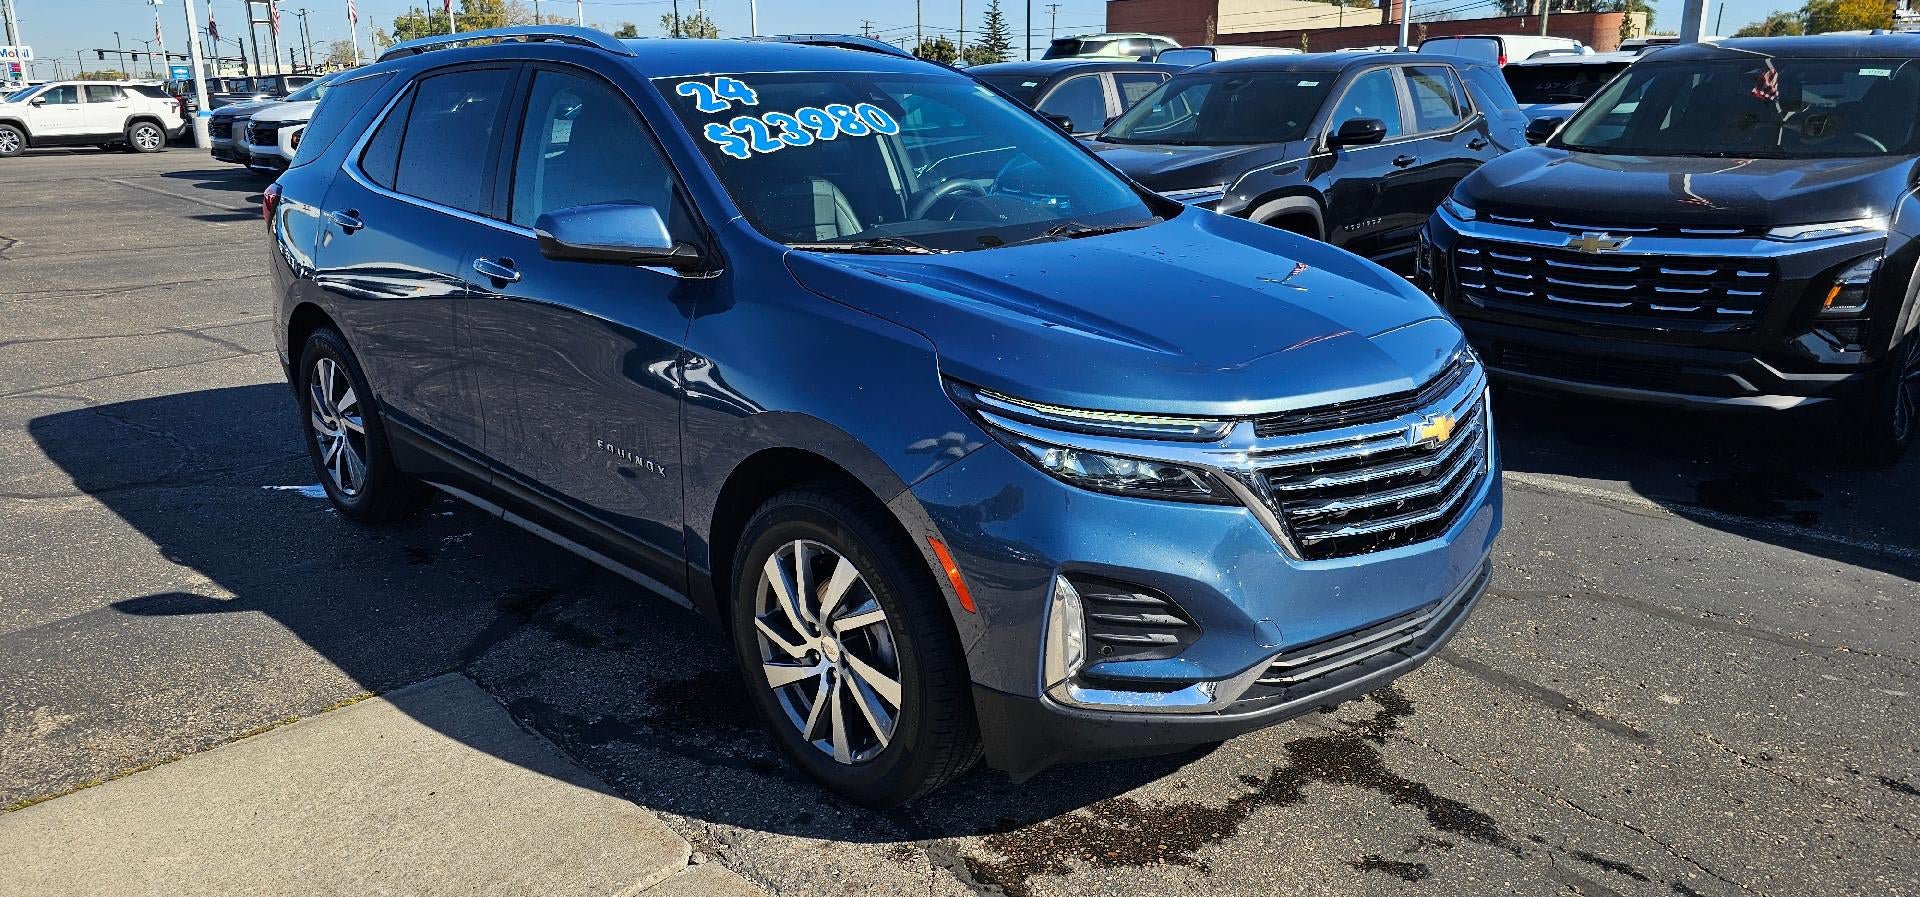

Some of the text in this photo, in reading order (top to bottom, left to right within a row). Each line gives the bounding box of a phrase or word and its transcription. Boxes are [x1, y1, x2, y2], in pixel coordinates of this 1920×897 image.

[676, 77, 759, 113] 24
[704, 103, 899, 159] $23980
[597, 439, 666, 477] EQUINOX
